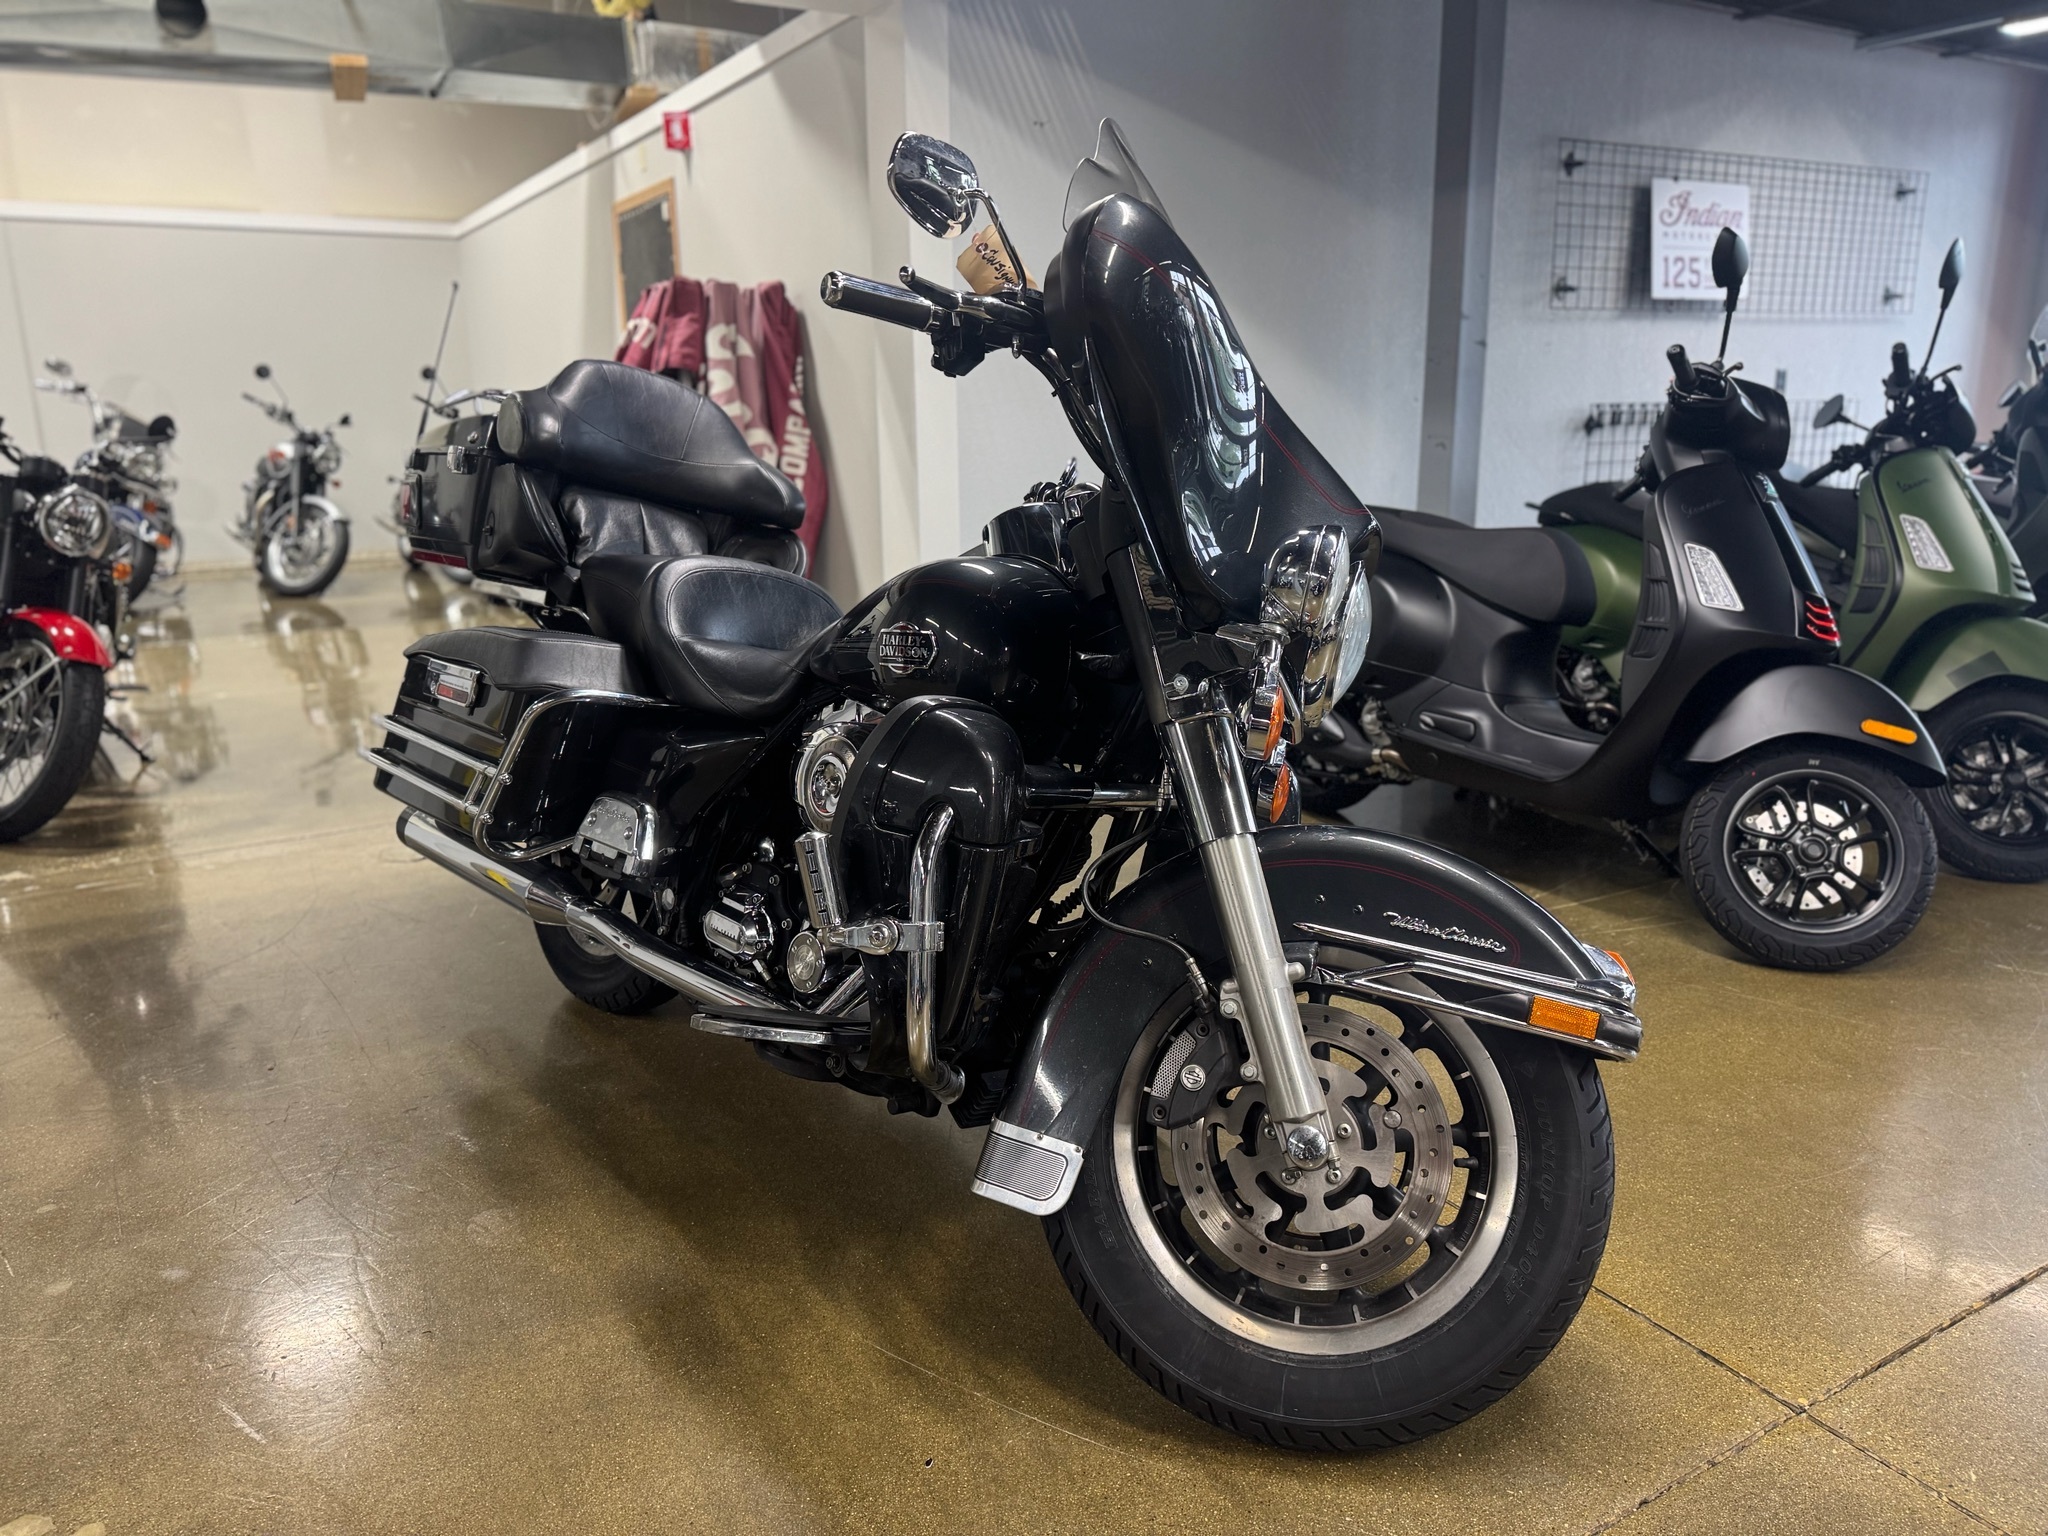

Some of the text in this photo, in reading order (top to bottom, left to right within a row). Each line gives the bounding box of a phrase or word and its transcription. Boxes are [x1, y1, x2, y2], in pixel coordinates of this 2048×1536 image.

[1659, 190, 1744, 229] Indian
[1663, 255, 1701, 288] 125
[879, 645, 929, 659] DAVIDSON
[1383, 911, 1507, 953] Ultra Classic
[1533, 1094, 1556, 1212] DUNLOP
